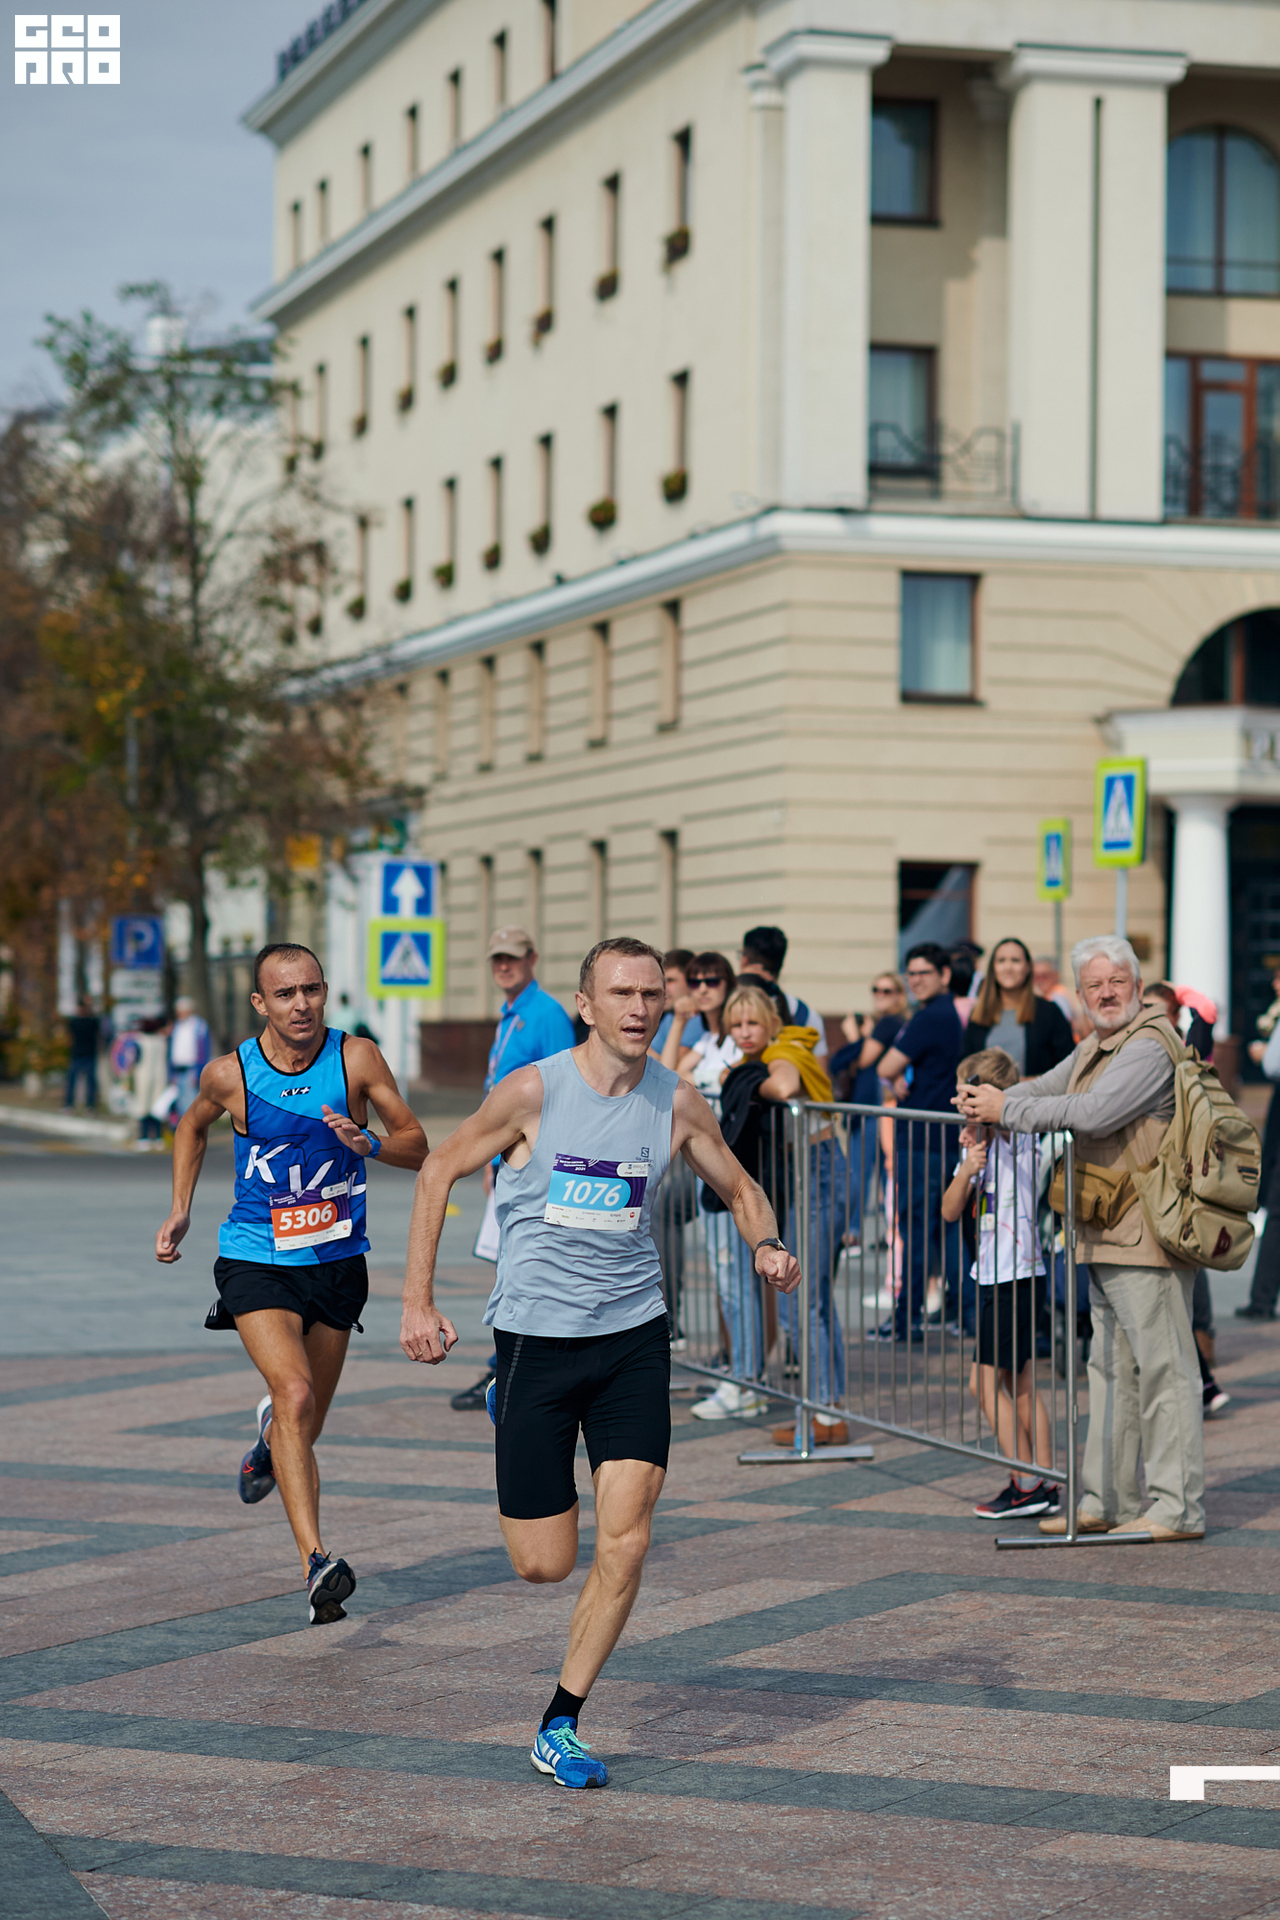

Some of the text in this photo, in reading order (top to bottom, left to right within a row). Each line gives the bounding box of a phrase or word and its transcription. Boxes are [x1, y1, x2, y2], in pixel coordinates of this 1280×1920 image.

[125, 920, 155, 962] P
[562, 1180, 622, 1206] 1076
[279, 1203, 332, 1230] 5306
